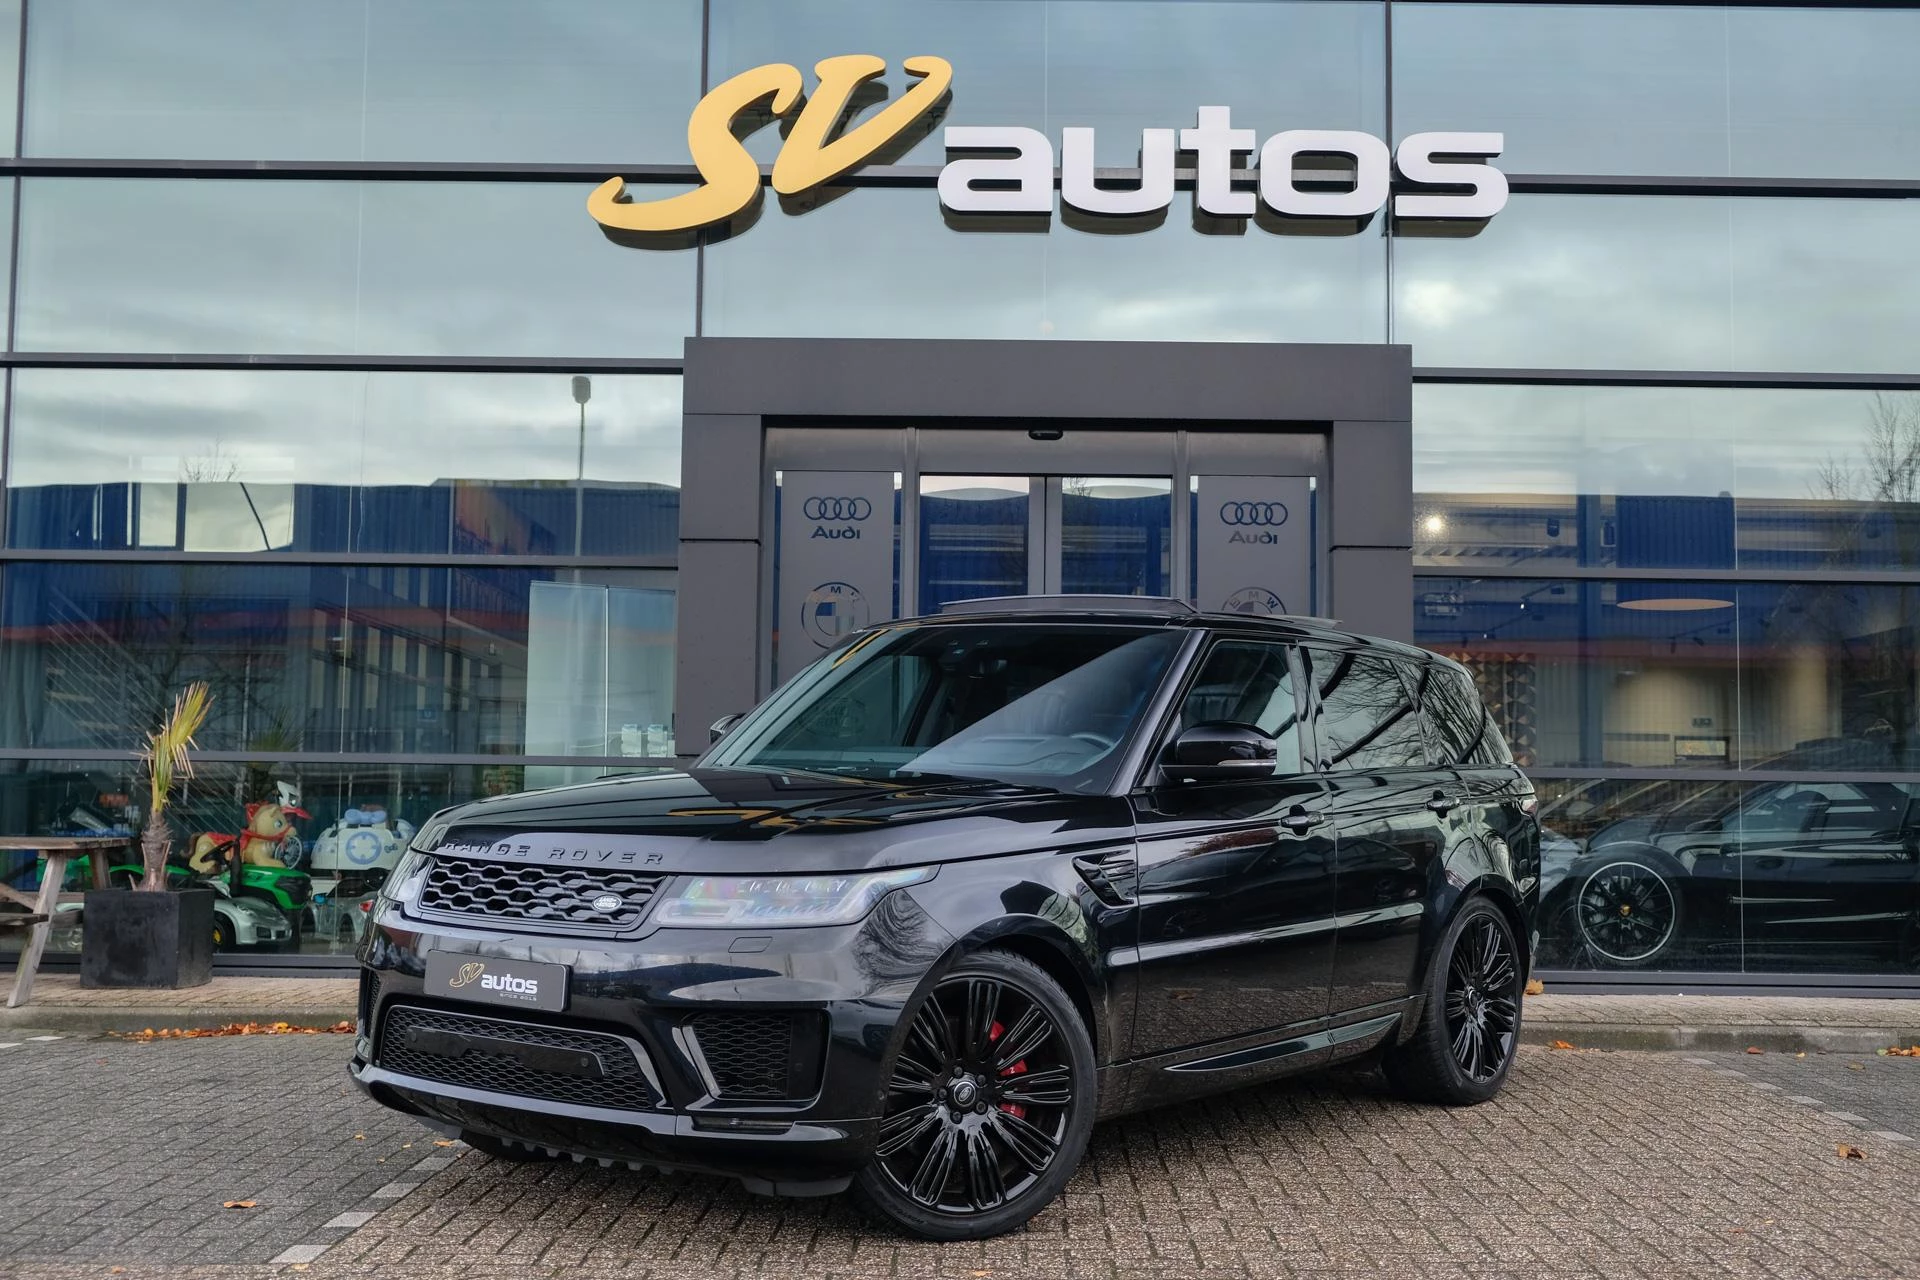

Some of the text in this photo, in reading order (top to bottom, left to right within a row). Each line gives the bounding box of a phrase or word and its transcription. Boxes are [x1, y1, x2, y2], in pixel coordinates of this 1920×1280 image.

[587, 53, 1510, 232] SV autos
[811, 526, 861, 539] Audi
[1229, 530, 1278, 544] Audi
[444, 838, 664, 865] RANGE ROVER
[449, 962, 538, 995] SV autos
